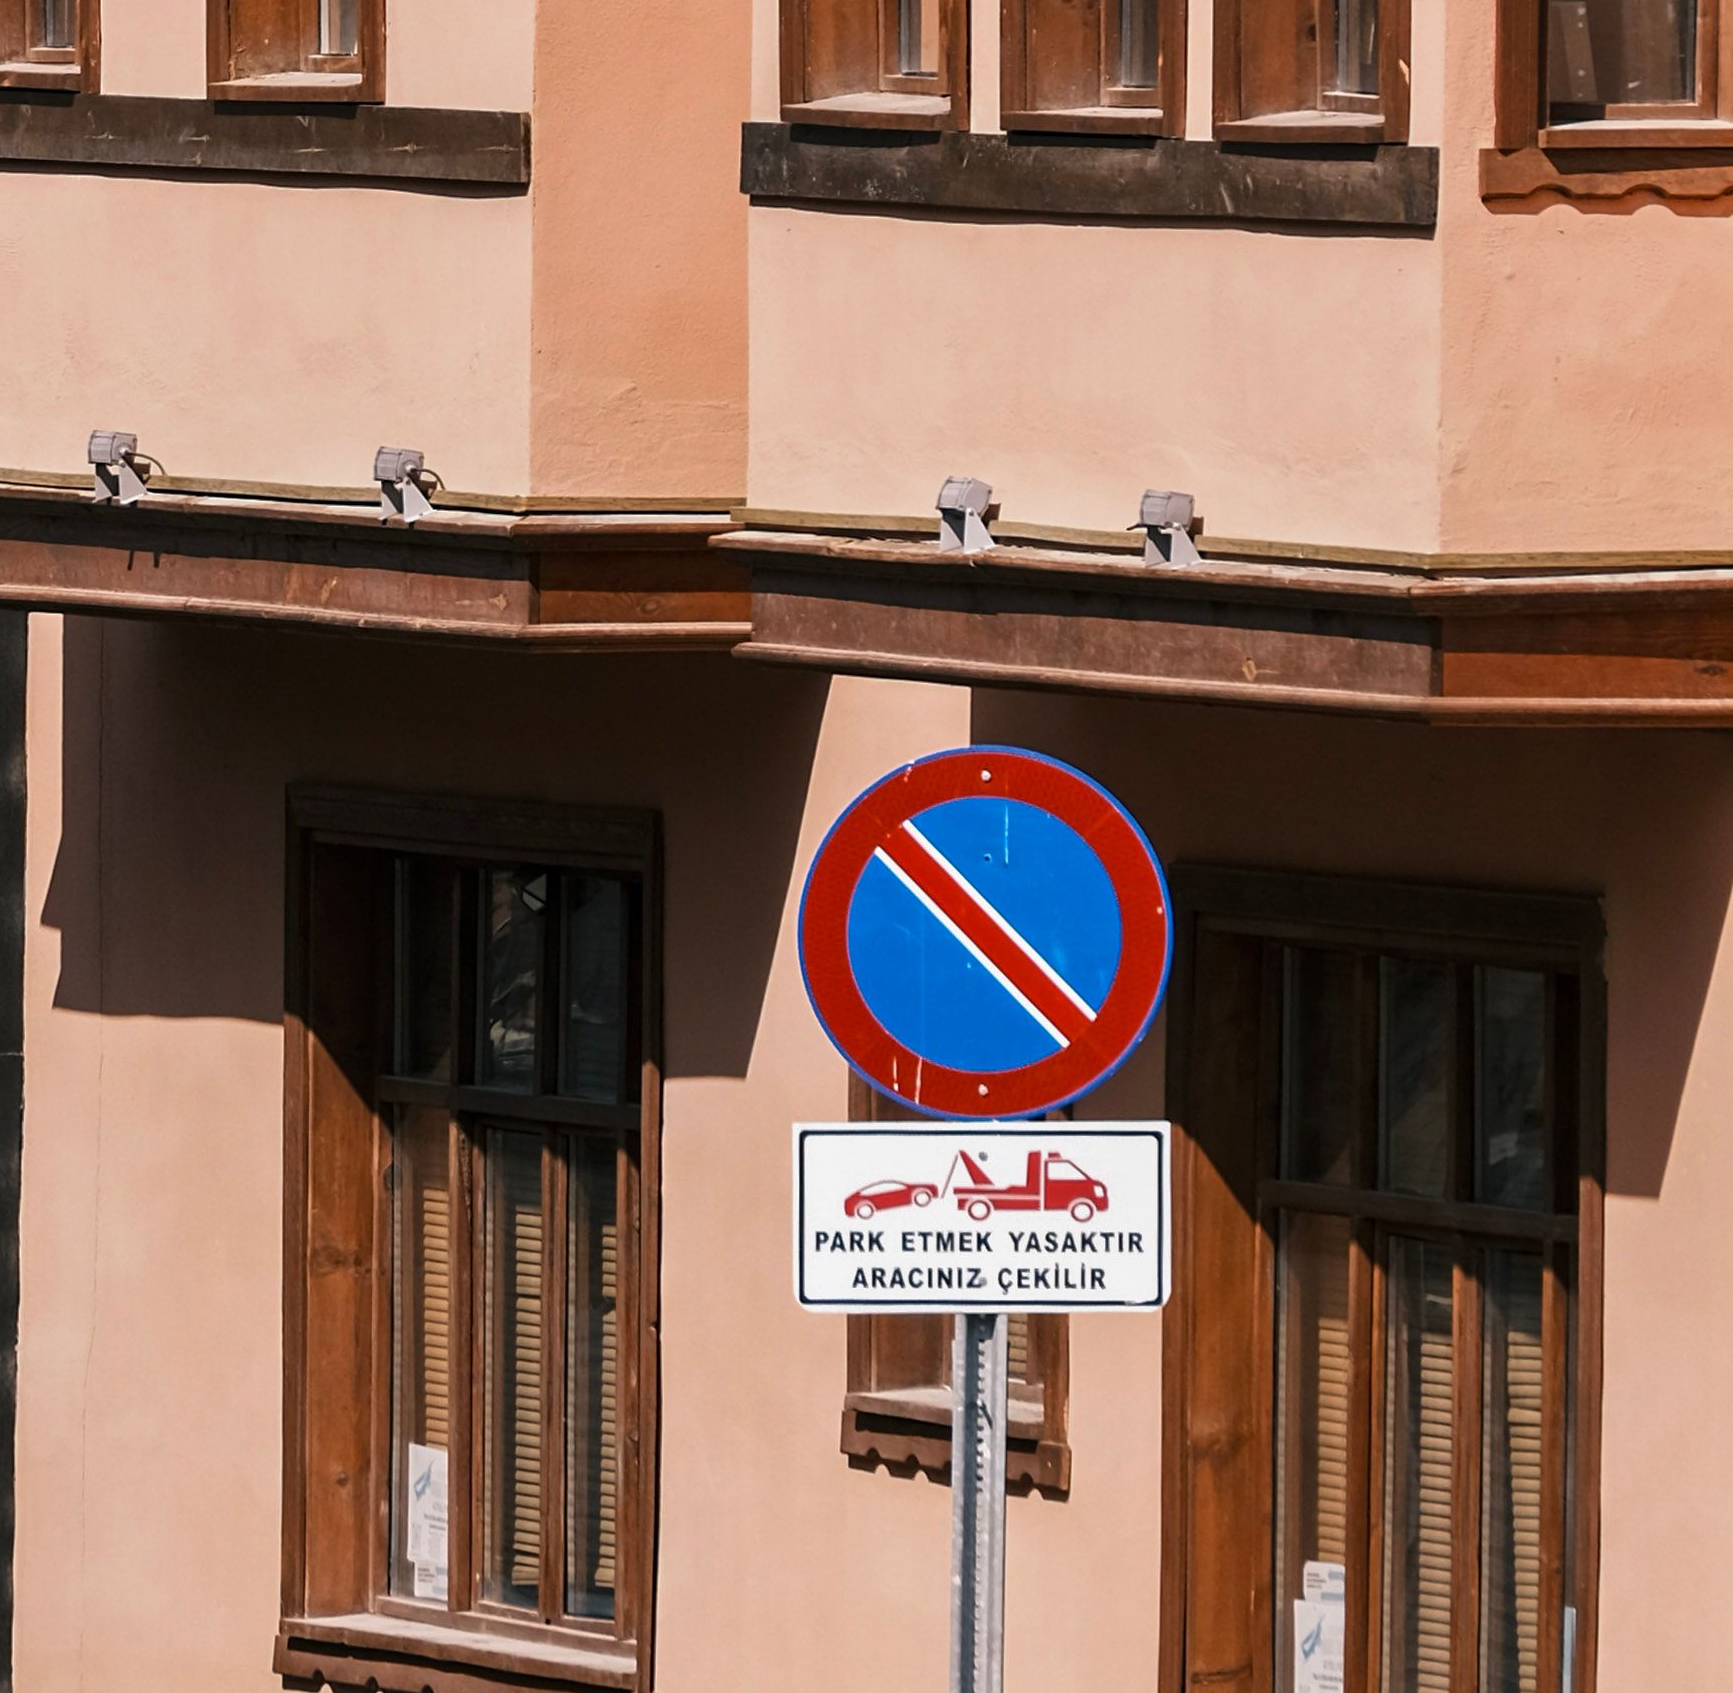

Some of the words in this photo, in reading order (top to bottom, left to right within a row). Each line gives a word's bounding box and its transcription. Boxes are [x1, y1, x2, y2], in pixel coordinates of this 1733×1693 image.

[815, 1231, 885, 1253] PARK
[901, 1231, 993, 1253] ETMEK
[1008, 1231, 1145, 1253] YASAKTIR
[852, 1267, 985, 1289] ARACINIZ
[997, 1263, 1107, 1294] ÇEKİLİR
